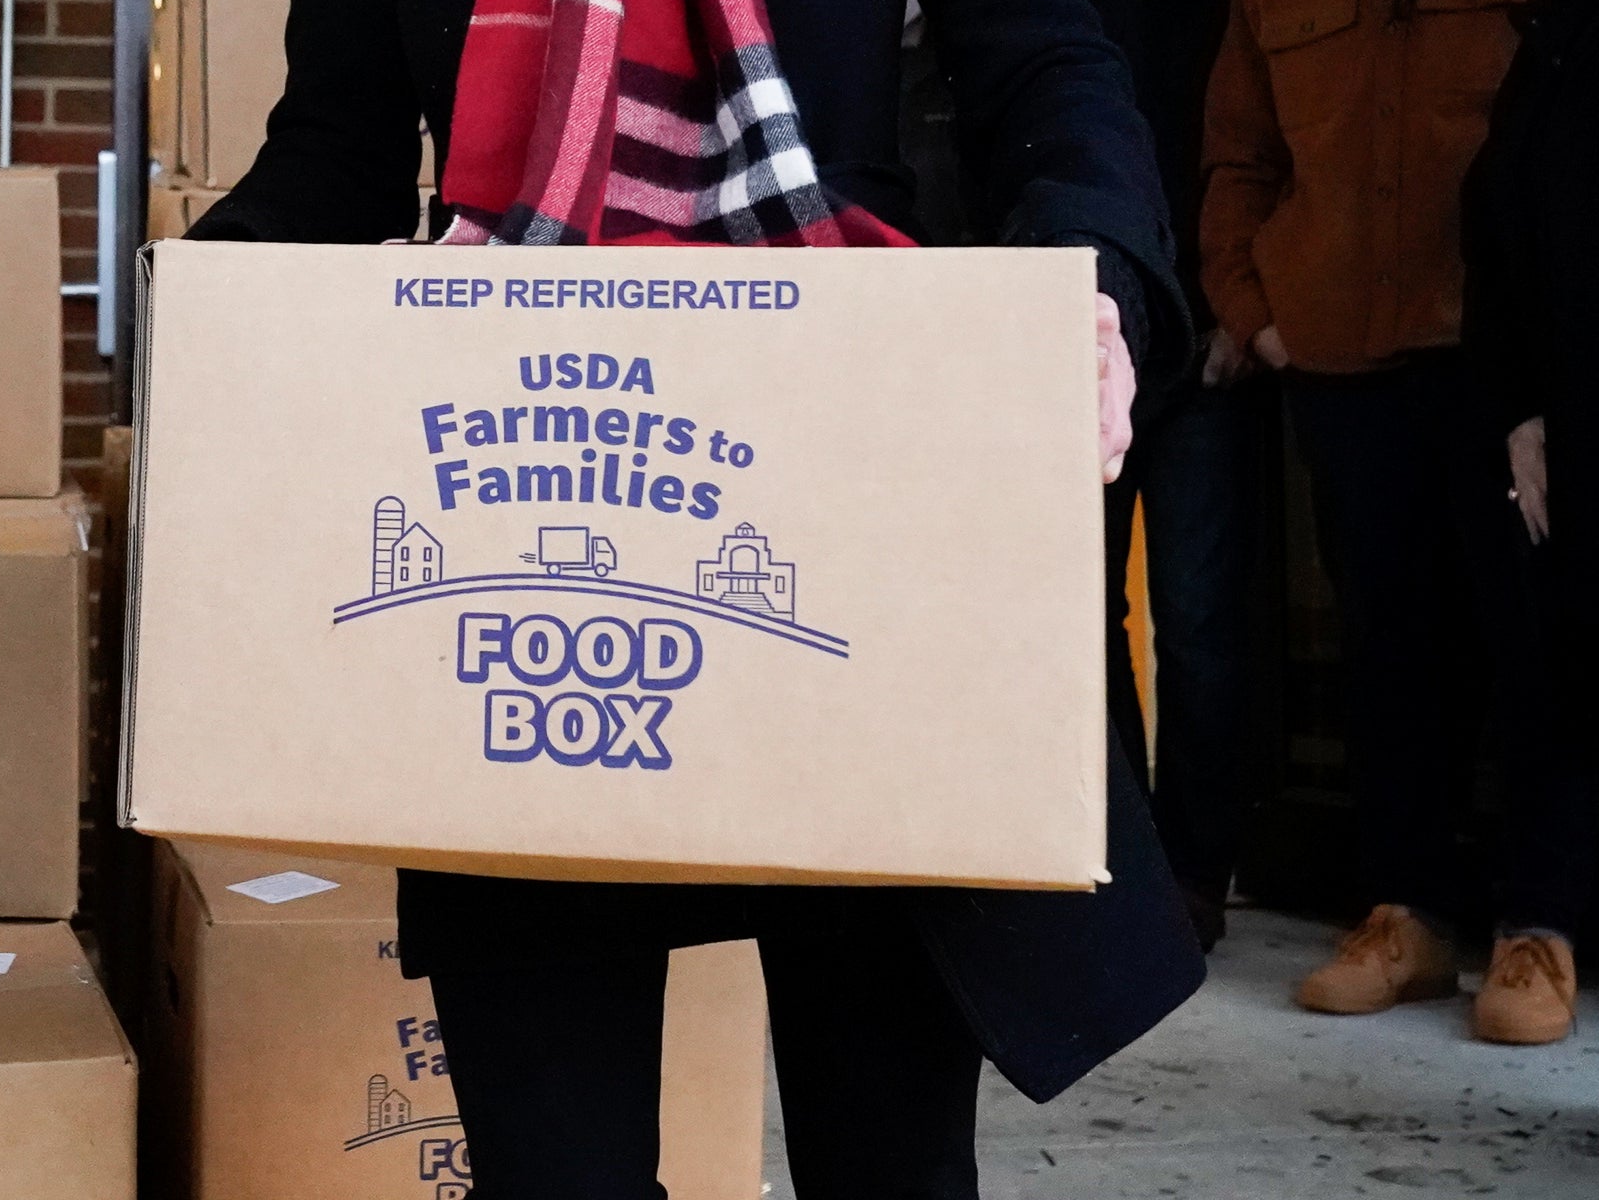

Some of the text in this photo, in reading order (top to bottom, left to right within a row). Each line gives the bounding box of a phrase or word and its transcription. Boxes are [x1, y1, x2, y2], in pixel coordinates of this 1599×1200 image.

[394, 278, 800, 310] KEEP REFRIGERATED
[519, 352, 655, 395] USDA
[421, 403, 755, 469] Farmers to
[434, 448, 722, 521] Families
[457, 612, 704, 692] FOOD
[484, 689, 673, 771] BOX
